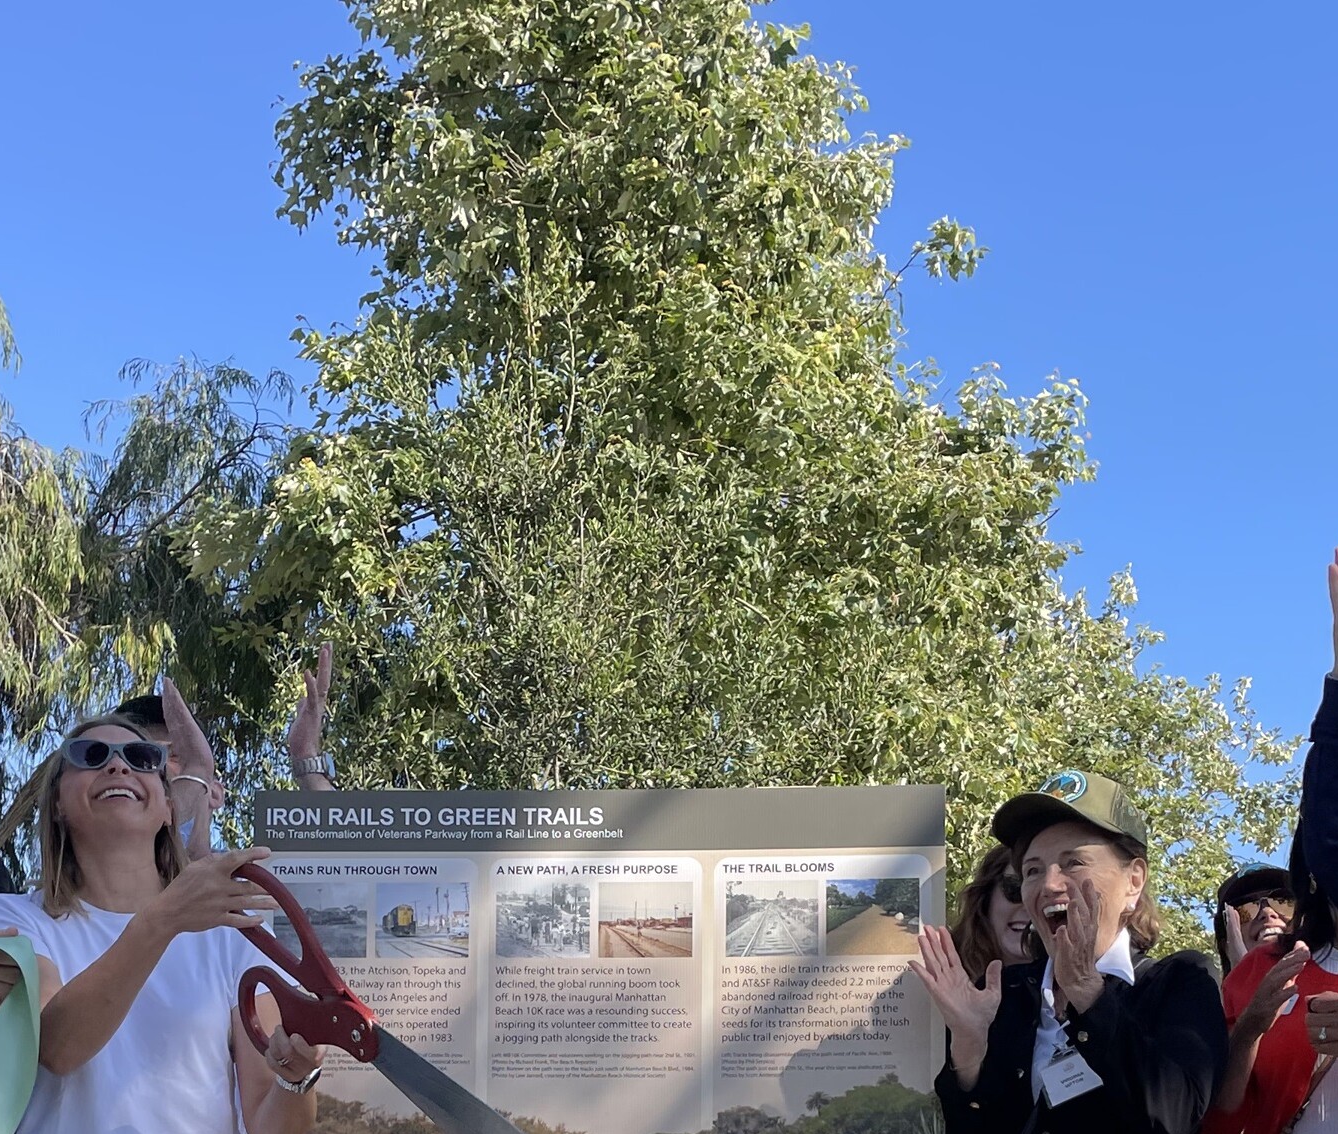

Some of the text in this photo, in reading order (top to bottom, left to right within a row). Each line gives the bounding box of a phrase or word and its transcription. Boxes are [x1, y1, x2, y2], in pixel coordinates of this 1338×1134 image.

[266, 807, 603, 826] IRON RAILS TO GREEN TRAILS
[266, 828, 623, 841] The Transformation of Veterans Parkway from a Rail Line to a Greenbelt
[273, 866, 438, 875] TRAINS RUN THROUGH TOWN
[497, 865, 677, 876] A NEW PATH, A FRESH PURPOSE
[723, 863, 834, 873] THE TRAIL BLOOMS
[350, 966, 366, 975] the
[368, 966, 410, 976] Atchison,
[413, 966, 446, 977] Topeka
[448, 966, 466, 975] and
[495, 966, 522, 974] While
[524, 966, 555, 977] freight
[557, 966, 578, 974] train
[581, 966, 613, 974] service
[616, 966, 625, 974] in
[722, 966, 730, 974] In
[734, 966, 758, 975] 1986,
[761, 965, 776, 974] the
[778, 965, 796, 973] idle
[798, 965, 820, 973] train
[822, 965, 850, 973] tracks
[350, 980, 384, 990] Railway
[404, 980, 442, 990] through
[444, 980, 461, 988] this
[495, 980, 680, 990] declined, the global running boom took
[722, 977, 903, 989] and AT&SF Railway deeded 2.2 miles of
[372, 993, 388, 1001] Los
[390, 993, 427, 1003] Angeles
[429, 993, 448, 1001] and
[512, 993, 521, 1002] In
[524, 993, 548, 1003] 1978,
[551, 993, 566, 1002] the
[568, 993, 612, 1004] inaugural
[615, 993, 666, 1002] Manhattan
[722, 993, 776, 1001] abandoned
[778, 992, 812, 1000] railroad
[816, 991, 874, 1002] right-of-way
[888, 991, 904, 999] the
[396, 1007, 428, 1015] service
[431, 1007, 460, 1015] ended
[495, 1007, 523, 1015] Beach
[526, 1007, 543, 1015] 10K
[595, 1007, 648, 1017] resounding
[722, 1005, 898, 1017] City of Manhattan Beach, planting the
[406, 1020, 448, 1030] operated
[495, 1020, 692, 1031] inspiring its volunteer committee to create
[722, 1018, 910, 1028] seeds for its transformation into the lush
[418, 1034, 427, 1042] in
[430, 1034, 454, 1042] 1983.
[502, 1034, 539, 1044] jogging
[541, 1034, 562, 1044] path
[565, 1034, 610, 1044] alongside
[613, 1034, 628, 1042] the
[722, 1033, 750, 1044] public
[753, 1033, 771, 1041] trail
[773, 1033, 811, 1043] enjoyed
[813, 1033, 826, 1043] by
[827, 1032, 860, 1041] visitors
